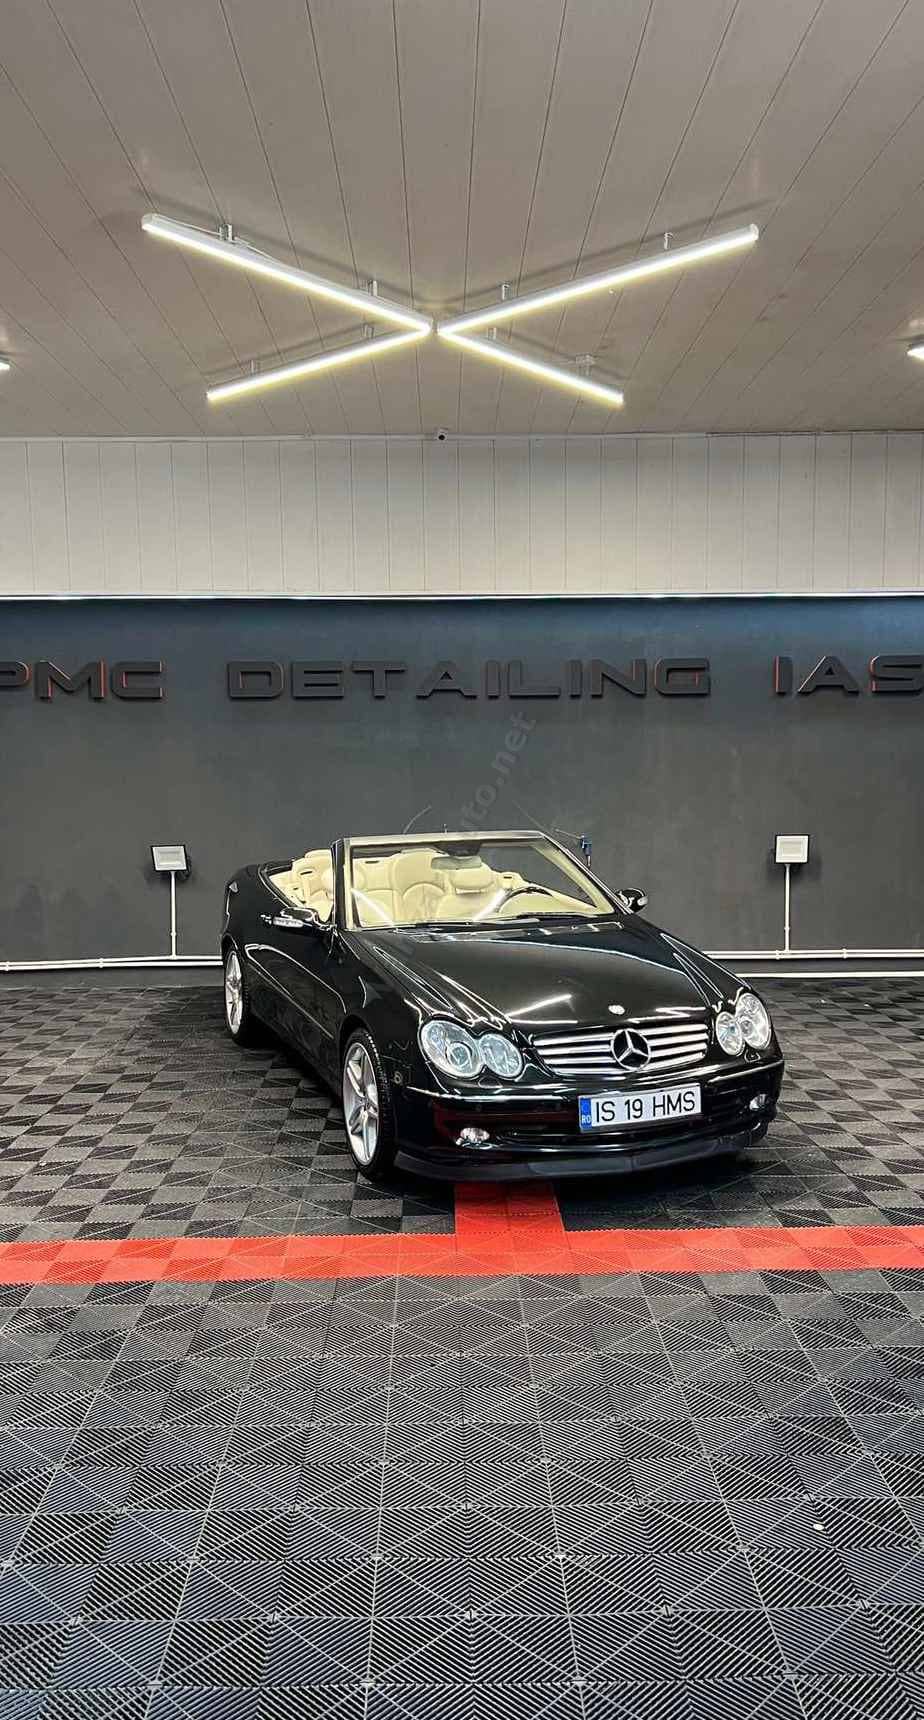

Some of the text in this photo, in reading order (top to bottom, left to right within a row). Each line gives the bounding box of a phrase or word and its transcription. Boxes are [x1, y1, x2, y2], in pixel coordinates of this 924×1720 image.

[226, 657, 711, 699] DETAILING
[773, 655, 924, 696] IAS
[596, 1091, 696, 1122] IS 19 HMS
